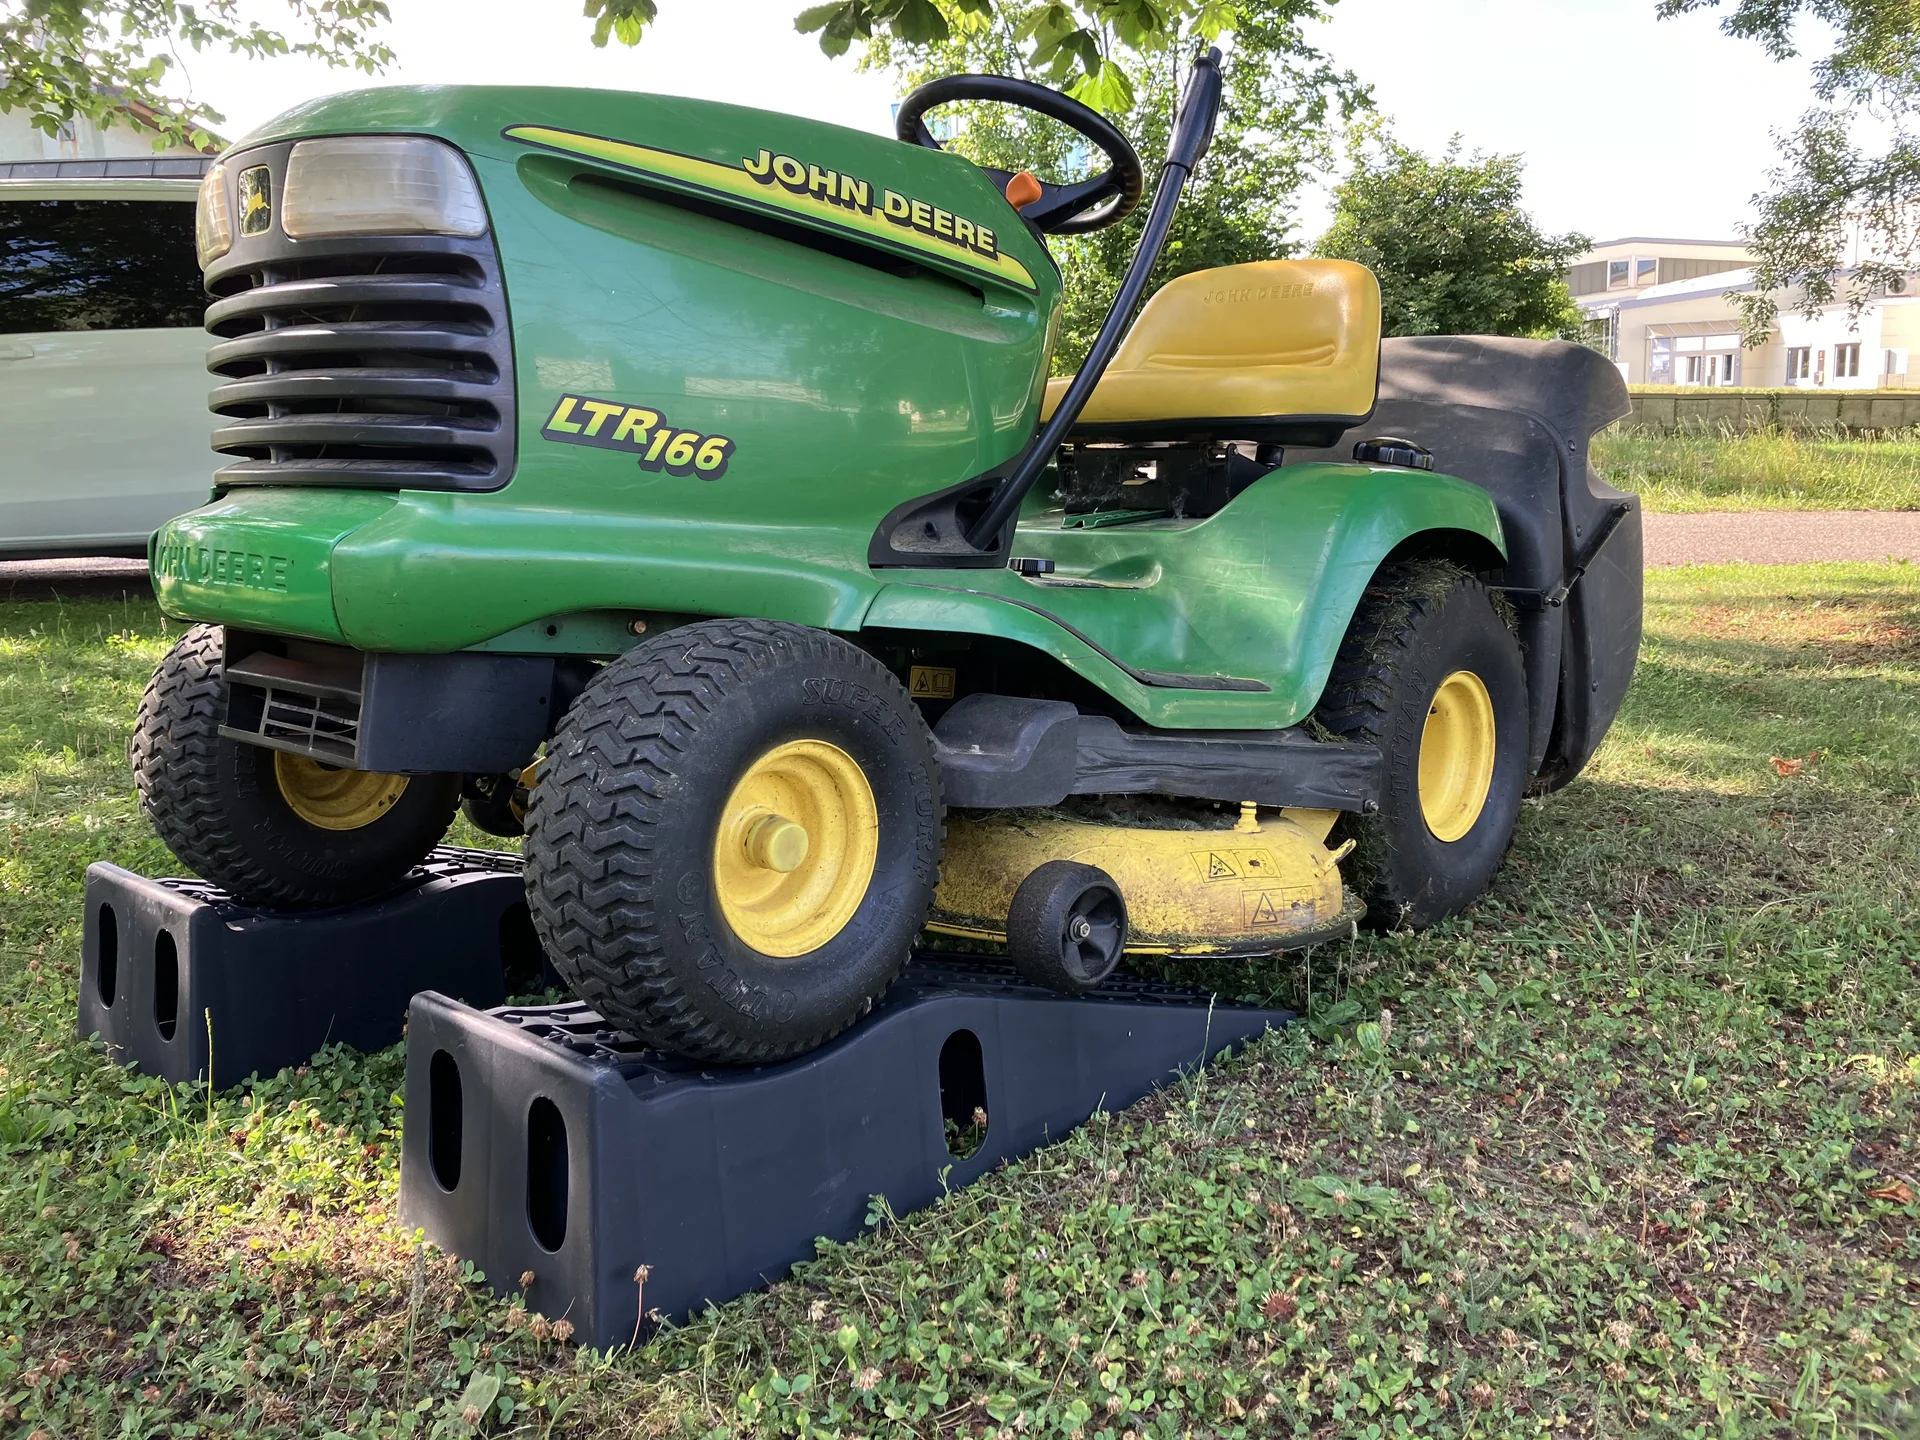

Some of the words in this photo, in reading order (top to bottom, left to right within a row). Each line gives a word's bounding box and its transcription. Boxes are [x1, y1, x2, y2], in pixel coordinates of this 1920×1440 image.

[742, 148, 873, 215] JOHN
[883, 187, 998, 259] DEERE
[1203, 288, 1252, 305] JOHN
[1258, 282, 1315, 301] DEERE
[546, 396, 659, 445] LTR
[644, 428, 729, 471] 166
[155, 544, 190, 581] OHN
[198, 547, 288, 593] DEERE
[802, 676, 909, 746] SUPER
[1390, 666, 1428, 798] TITAN
[678, 912, 768, 1022] TITAN
